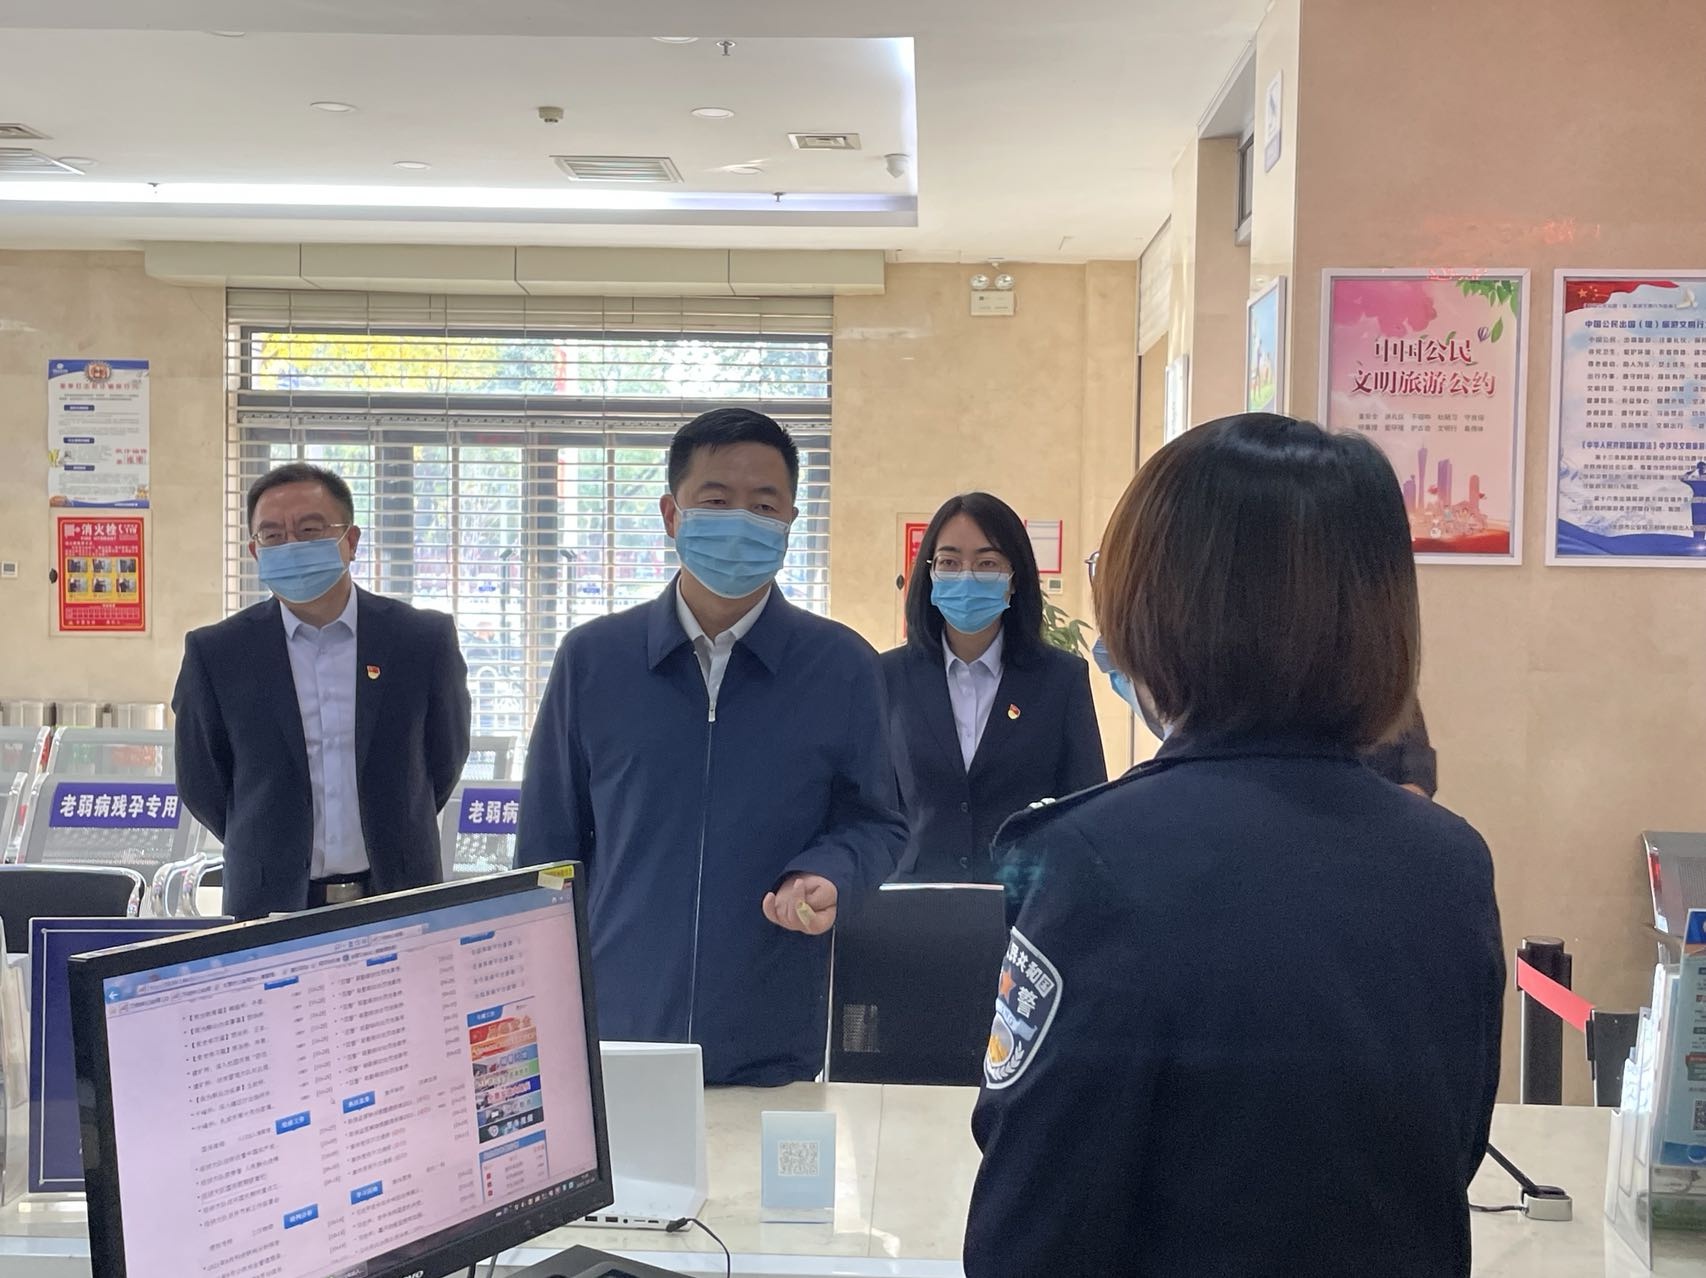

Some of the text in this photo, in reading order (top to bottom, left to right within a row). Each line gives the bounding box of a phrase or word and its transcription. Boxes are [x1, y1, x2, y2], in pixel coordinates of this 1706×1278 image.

[1375, 338, 1473, 363] 中国公民
[1351, 369, 1497, 395] 文明旅游公约
[81, 523, 117, 536] 消火栓
[60, 793, 179, 818] 老弱病残孕专用
[468, 800, 519, 824] 老弱病
